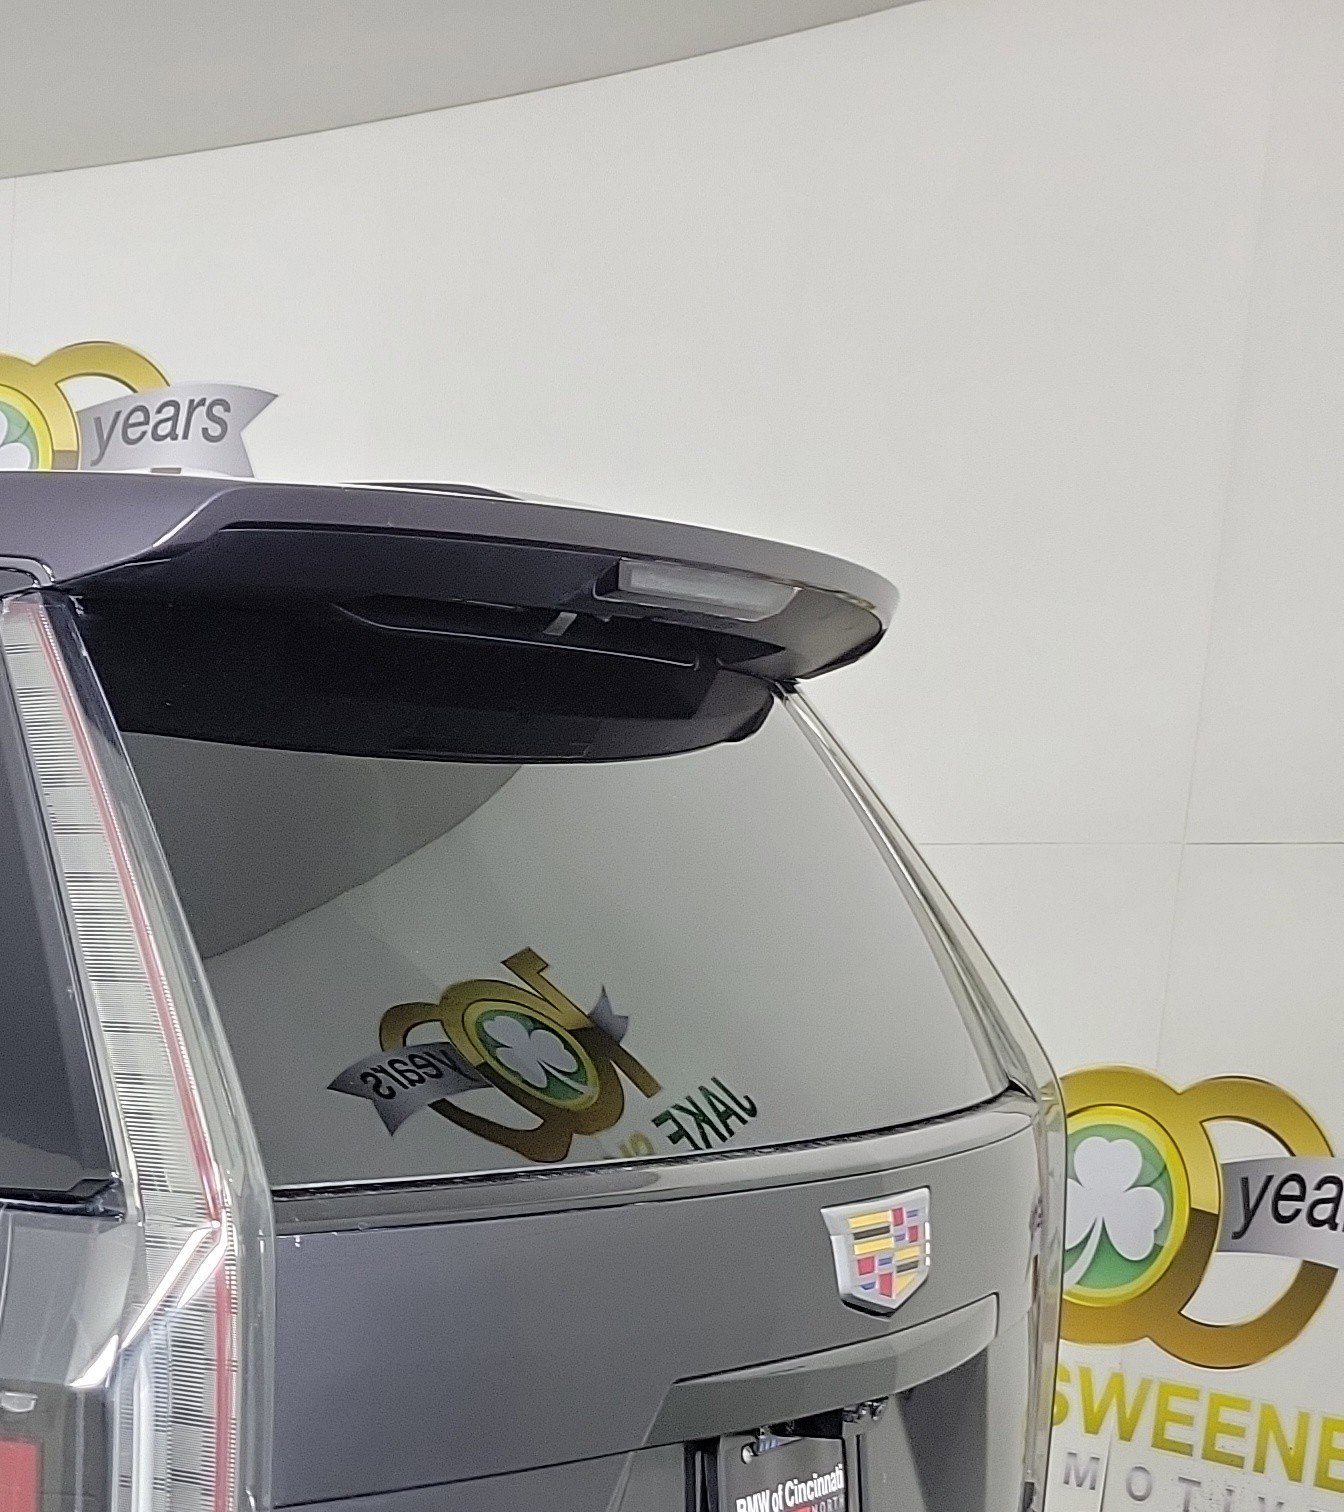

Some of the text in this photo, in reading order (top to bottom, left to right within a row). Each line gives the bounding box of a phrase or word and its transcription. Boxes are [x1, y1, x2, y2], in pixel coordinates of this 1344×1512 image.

[91, 390, 232, 467] years
[1231, 1171, 1344, 1240] yea
[771, 1484, 785, 1512] of
[784, 1462, 845, 1508] Cincinnati
